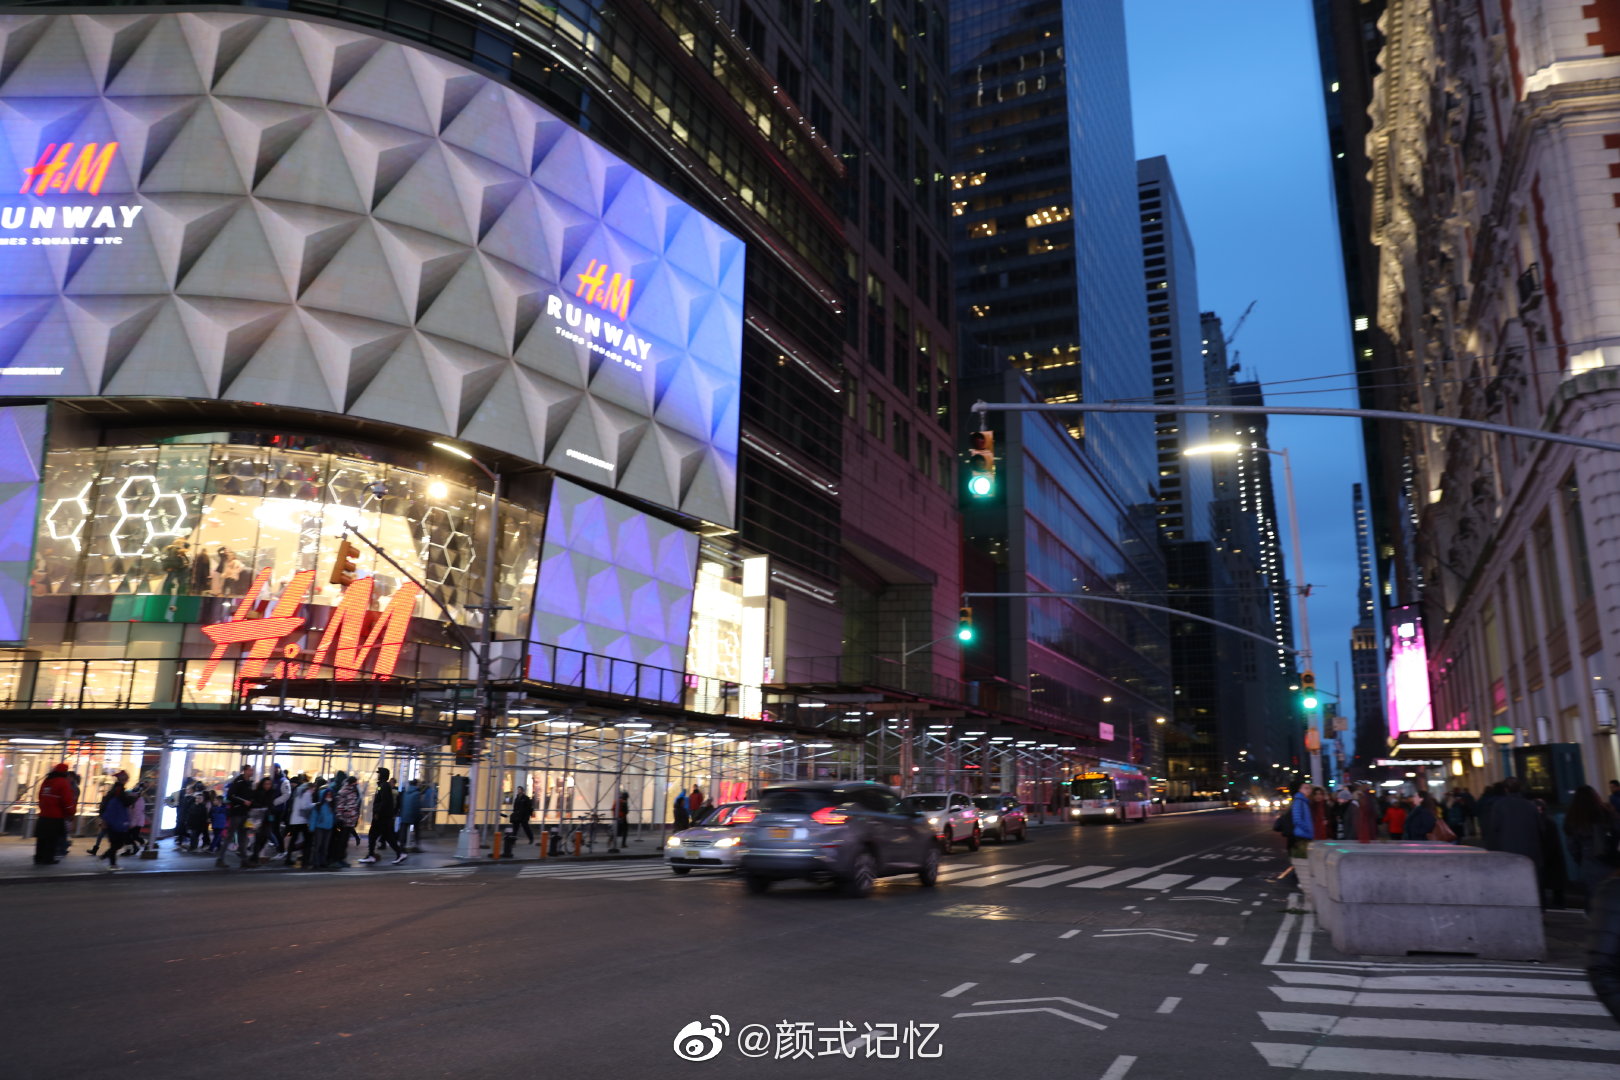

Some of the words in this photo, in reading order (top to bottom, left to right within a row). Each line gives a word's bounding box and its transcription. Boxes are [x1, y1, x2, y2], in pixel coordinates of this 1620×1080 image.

[19, 141, 119, 196] H&M
[575, 258, 635, 322] H&M
[547, 294, 652, 360] RUNWAY
